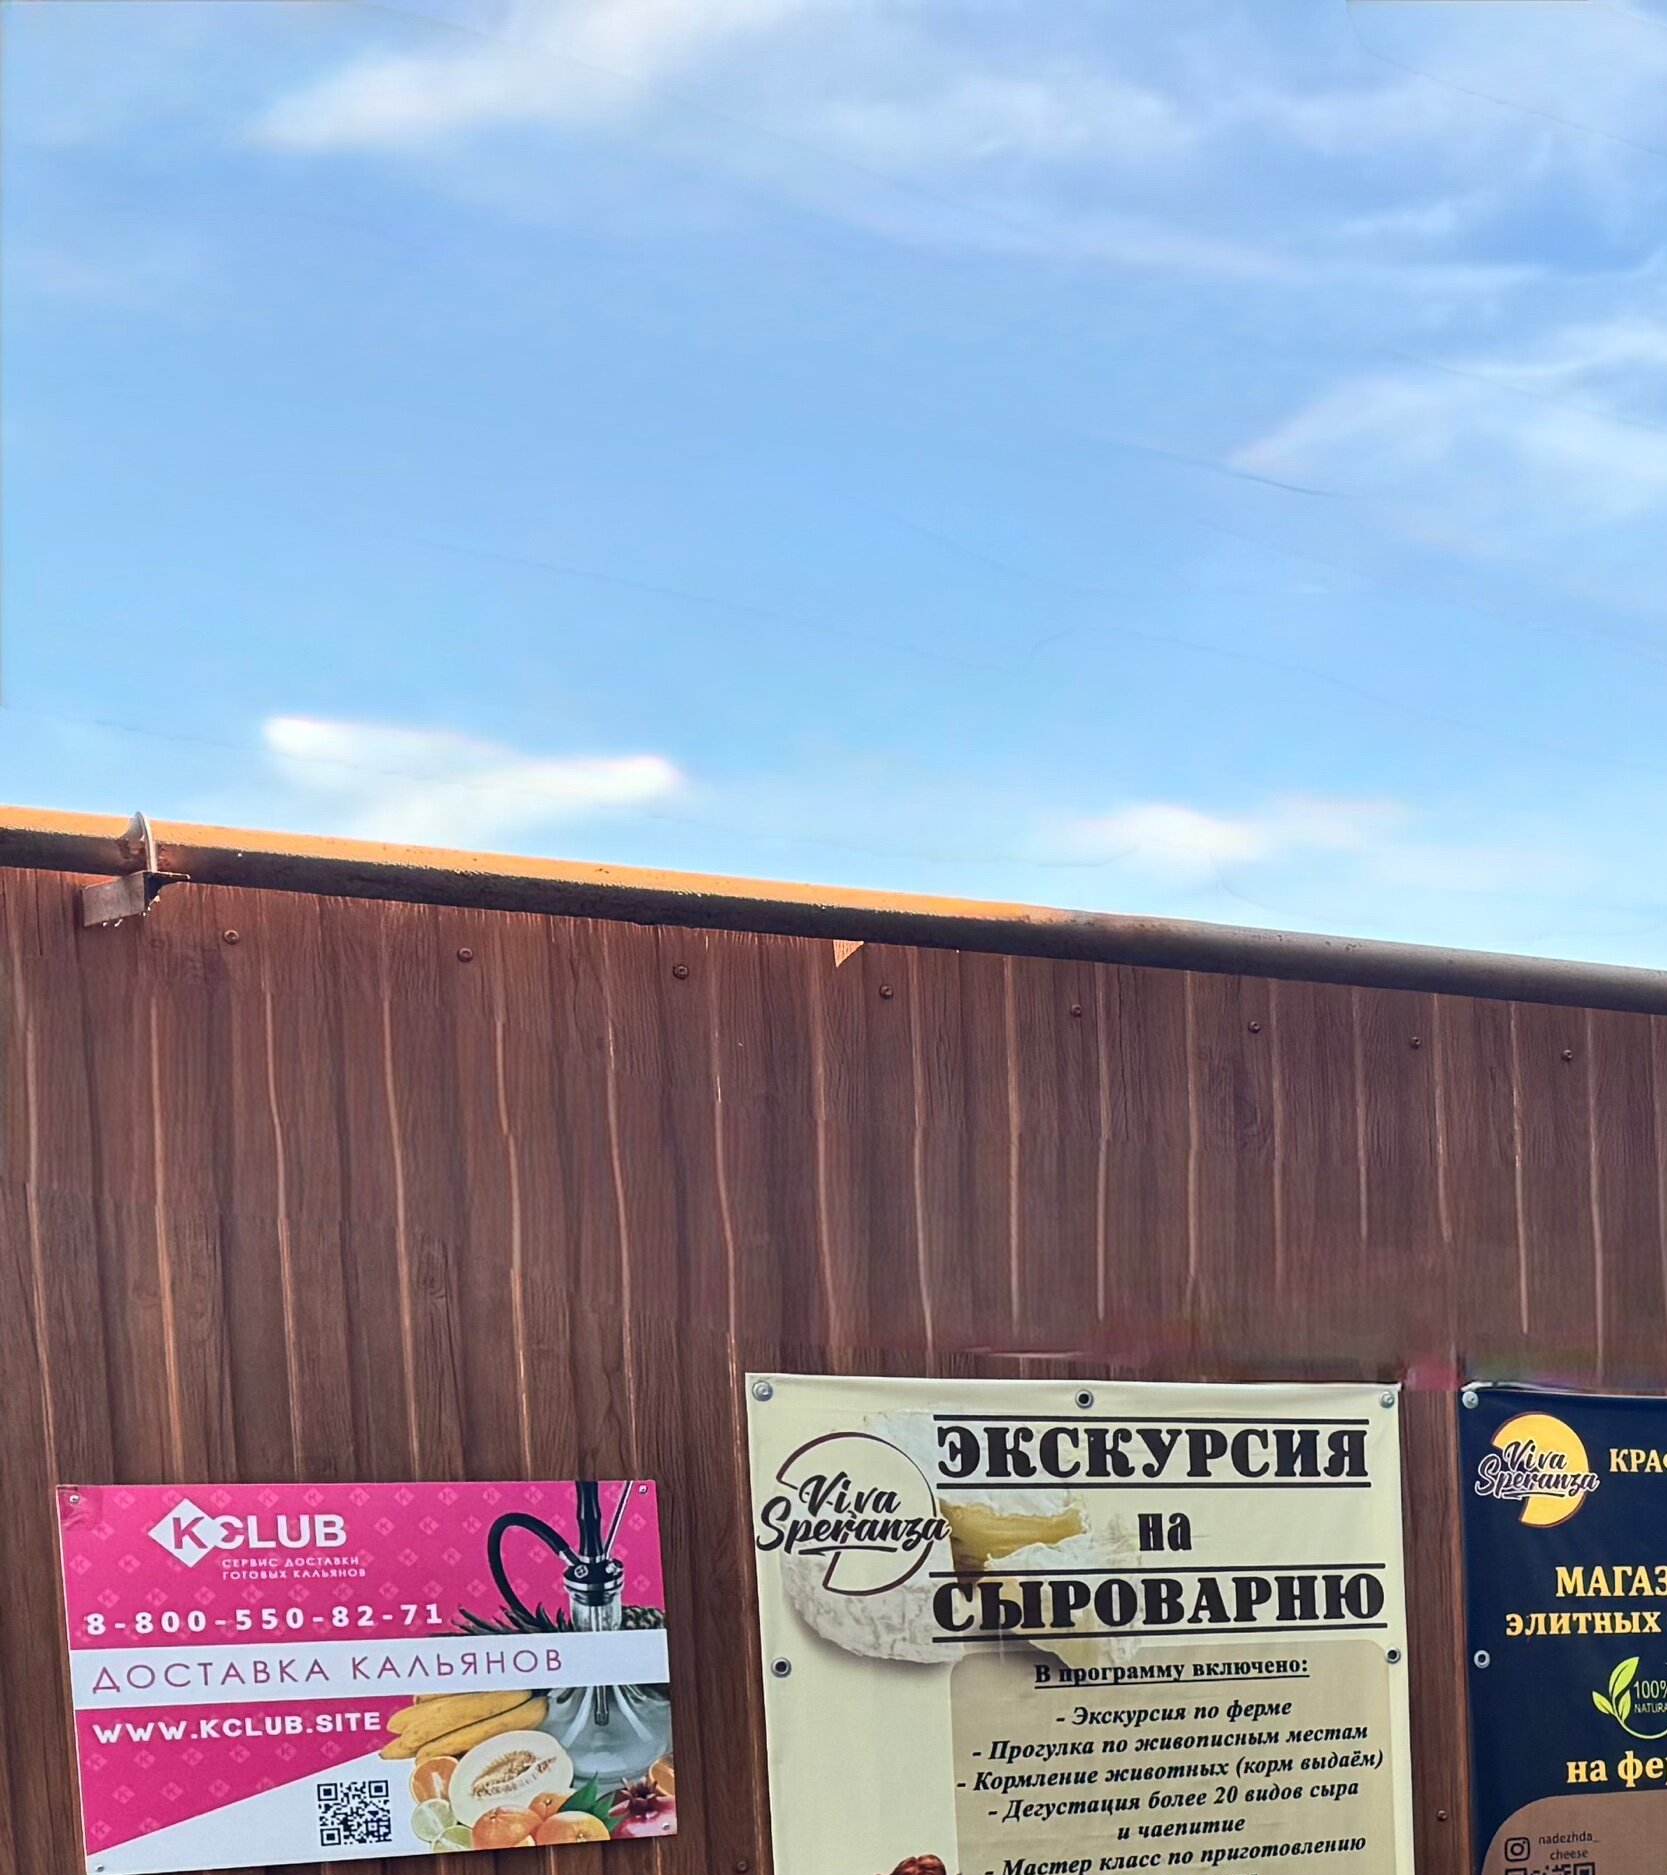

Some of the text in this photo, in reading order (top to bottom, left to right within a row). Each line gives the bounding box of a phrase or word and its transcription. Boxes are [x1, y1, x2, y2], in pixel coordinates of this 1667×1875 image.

[936, 1424, 1368, 1479] ЭКСКУРСИЯ
[1503, 1440, 1568, 1474] Viva
[800, 1471, 901, 1516] Viva
[1474, 1454, 1600, 1500] Speranza
[755, 1496, 951, 1555] Speranza
[1138, 1512, 1192, 1552] на
[222, 1556, 359, 1568] СЕРВИС ДОСТАВКИ
[223, 1568, 366, 1580] ГОТОВЫХ КАЛЬЯНОВ
[932, 1572, 1385, 1632] СЫРОВАРНЮ
[86, 1603, 442, 1637] 8-800-550-82-71
[1505, 1610, 1661, 1638] элитных
[92, 1648, 563, 1695] ДОСТАВКА КАЛЬЯНОВ
[1035, 1659, 1308, 1685] В программу включено:
[92, 1711, 381, 1744] WWW.KCLUB.SITE
[1072, 1700, 1292, 1727] Экскурсия по ферме
[989, 1726, 1368, 1763] Прогулка по живописным местам
[973, 1750, 1383, 1793] Кормление животных (корм выдаём)
[1566, 1758, 1608, 1784] на
[1002, 1781, 1359, 1822] Дегустация более 20 видов сыра
[1117, 1818, 1245, 1840] и чаепитие
[1100, 1852, 1161, 1871] класс
[1168, 1850, 1193, 1865] по
[1201, 1837, 1366, 1866] приготовлению
[1550, 1849, 1589, 1861] cheese
